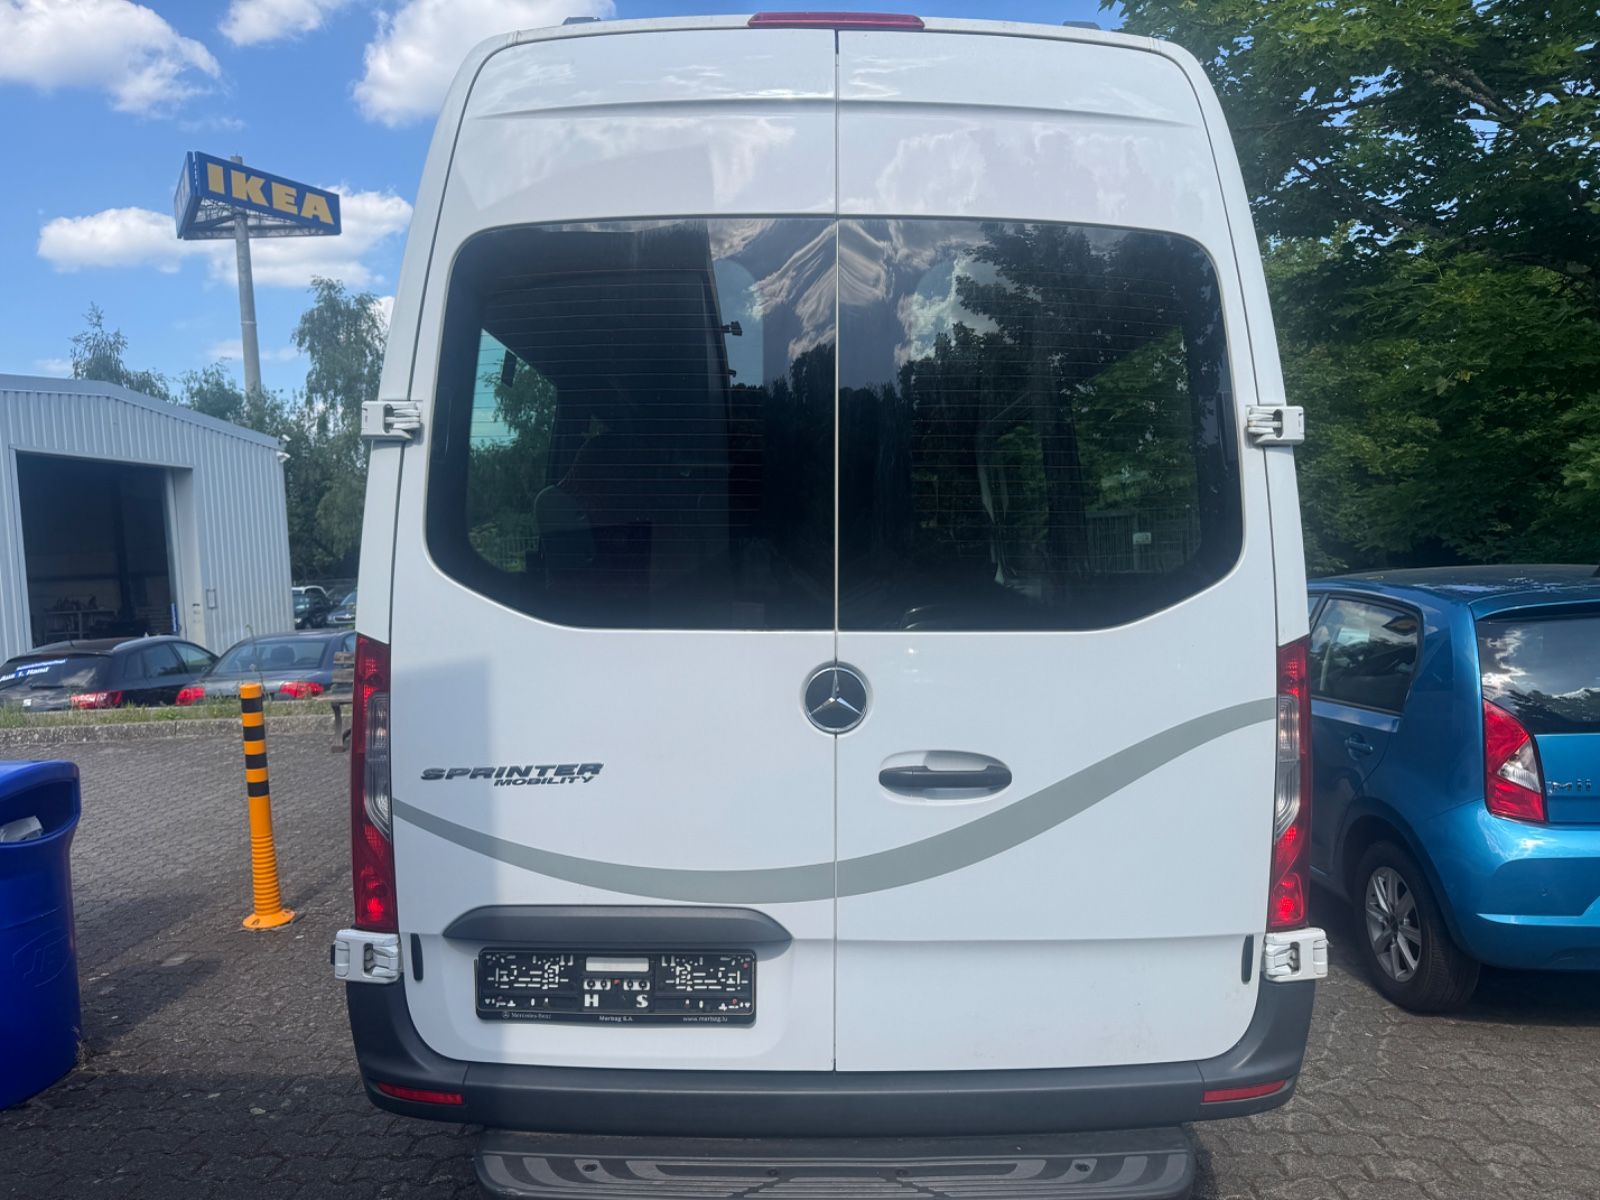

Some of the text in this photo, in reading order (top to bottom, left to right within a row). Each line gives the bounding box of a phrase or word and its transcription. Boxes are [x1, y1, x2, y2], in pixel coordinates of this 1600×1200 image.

[207, 162, 334, 225] IKEA
[420, 763, 604, 781] SPRINTER
[493, 776, 594, 787] MOBILITY
